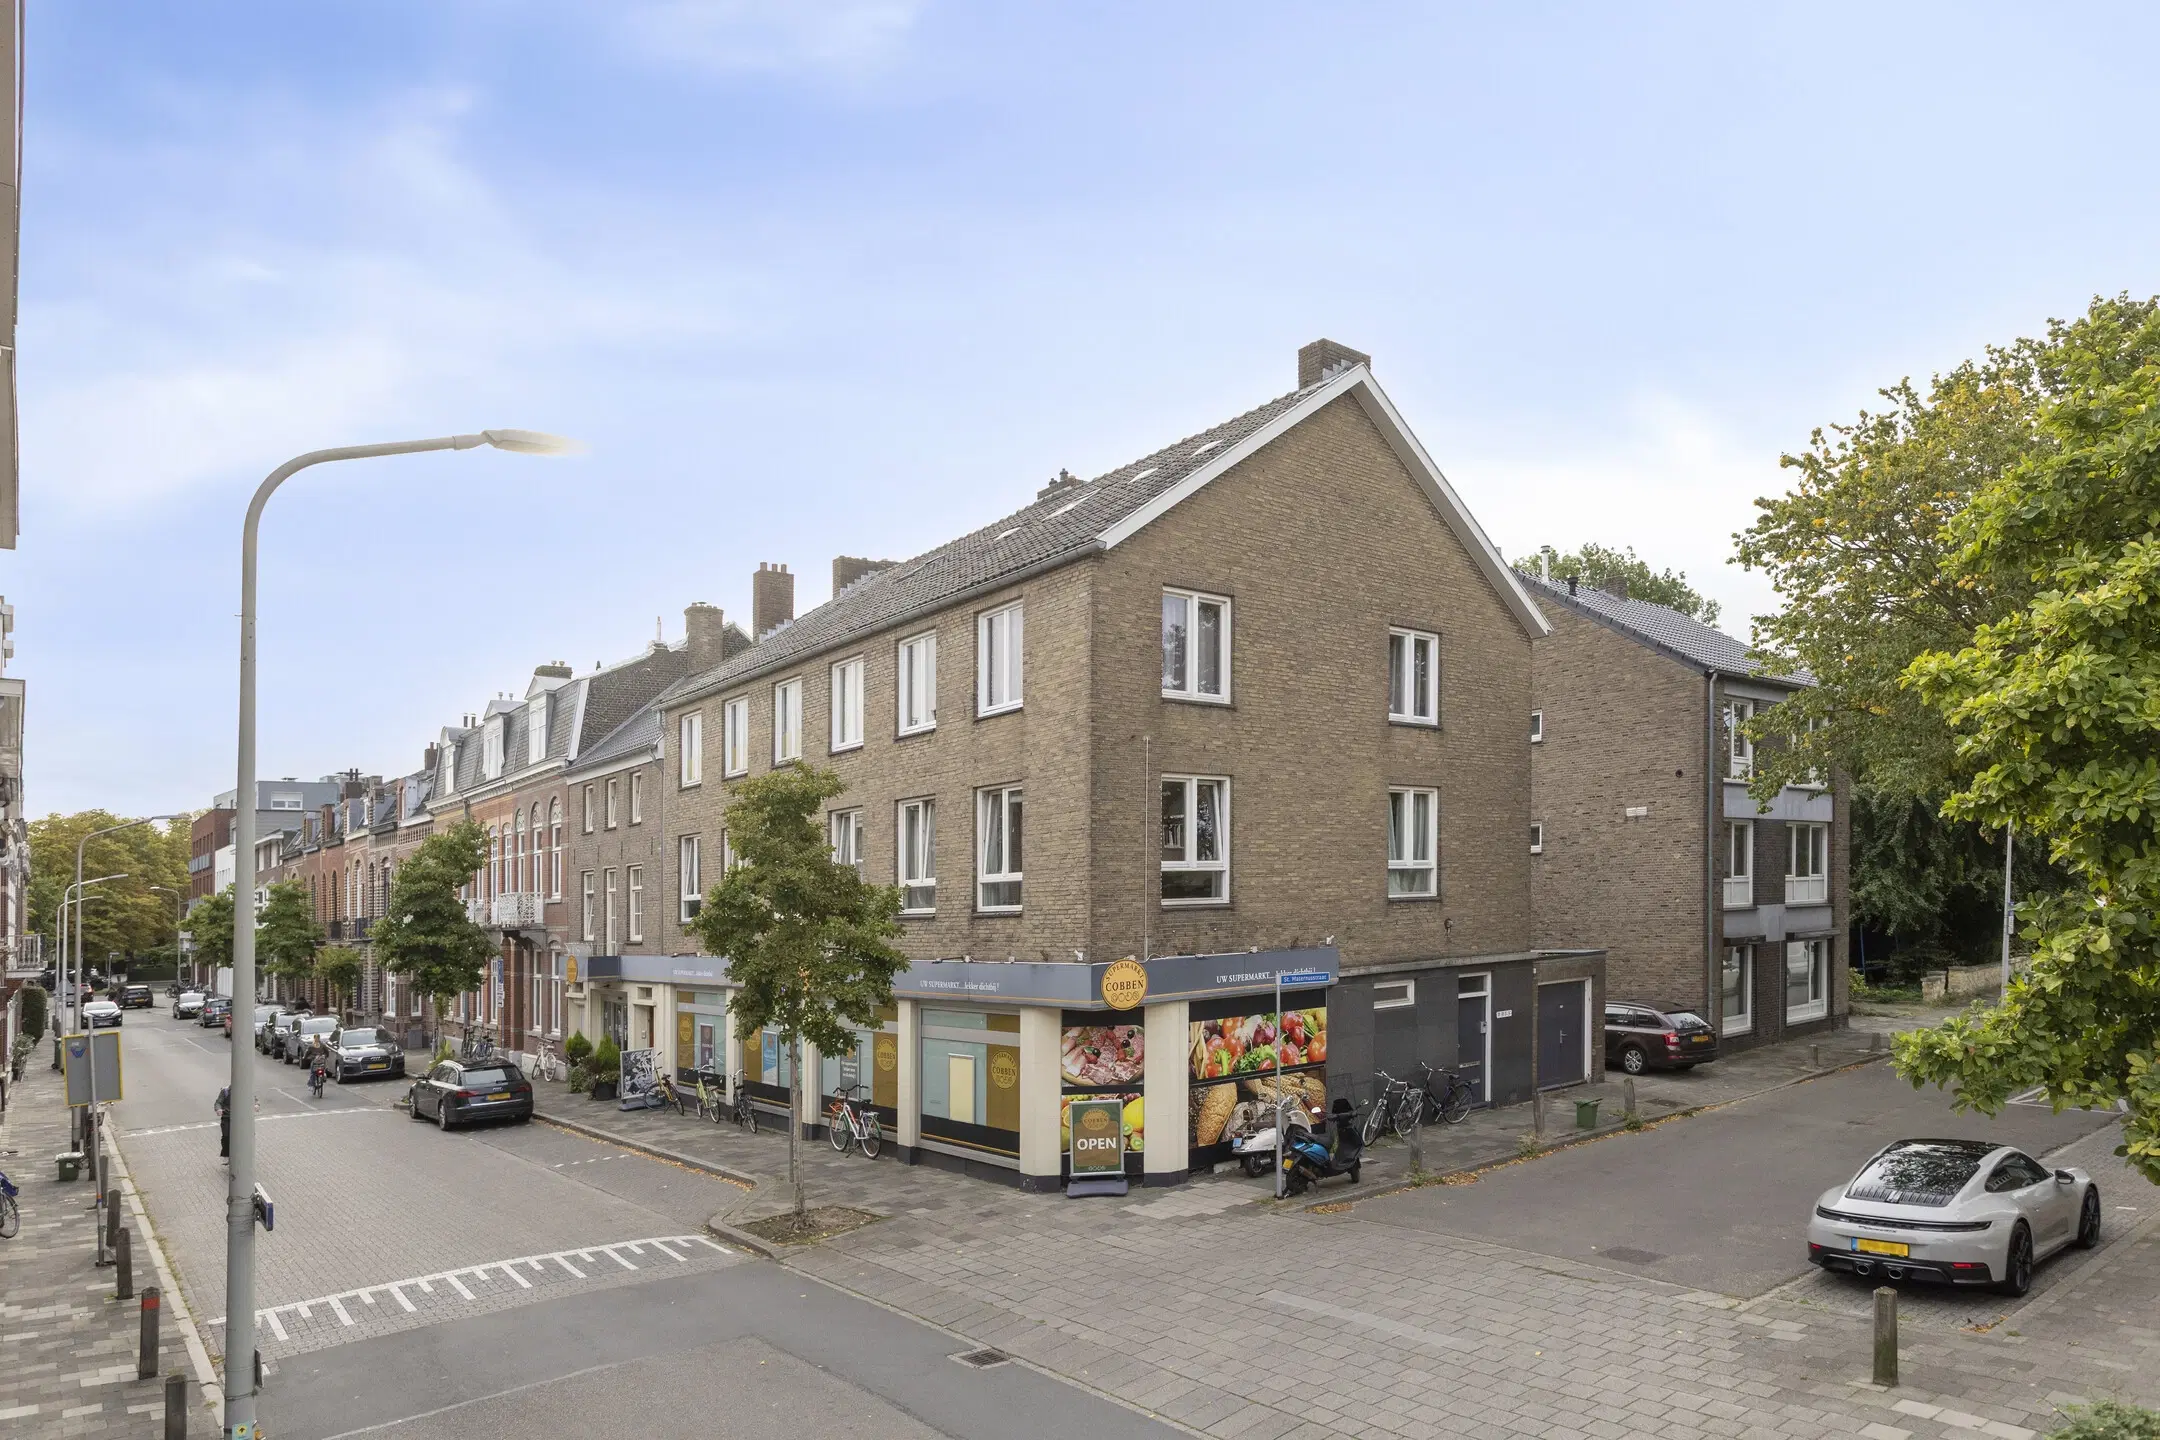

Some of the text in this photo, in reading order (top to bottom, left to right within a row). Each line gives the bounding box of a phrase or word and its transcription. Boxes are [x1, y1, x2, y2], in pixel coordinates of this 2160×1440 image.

[1106, 962, 1144, 981] SUPERMARKT
[1106, 980, 1144, 992] COBBEN
[1077, 1137, 1117, 1150] OPEN
